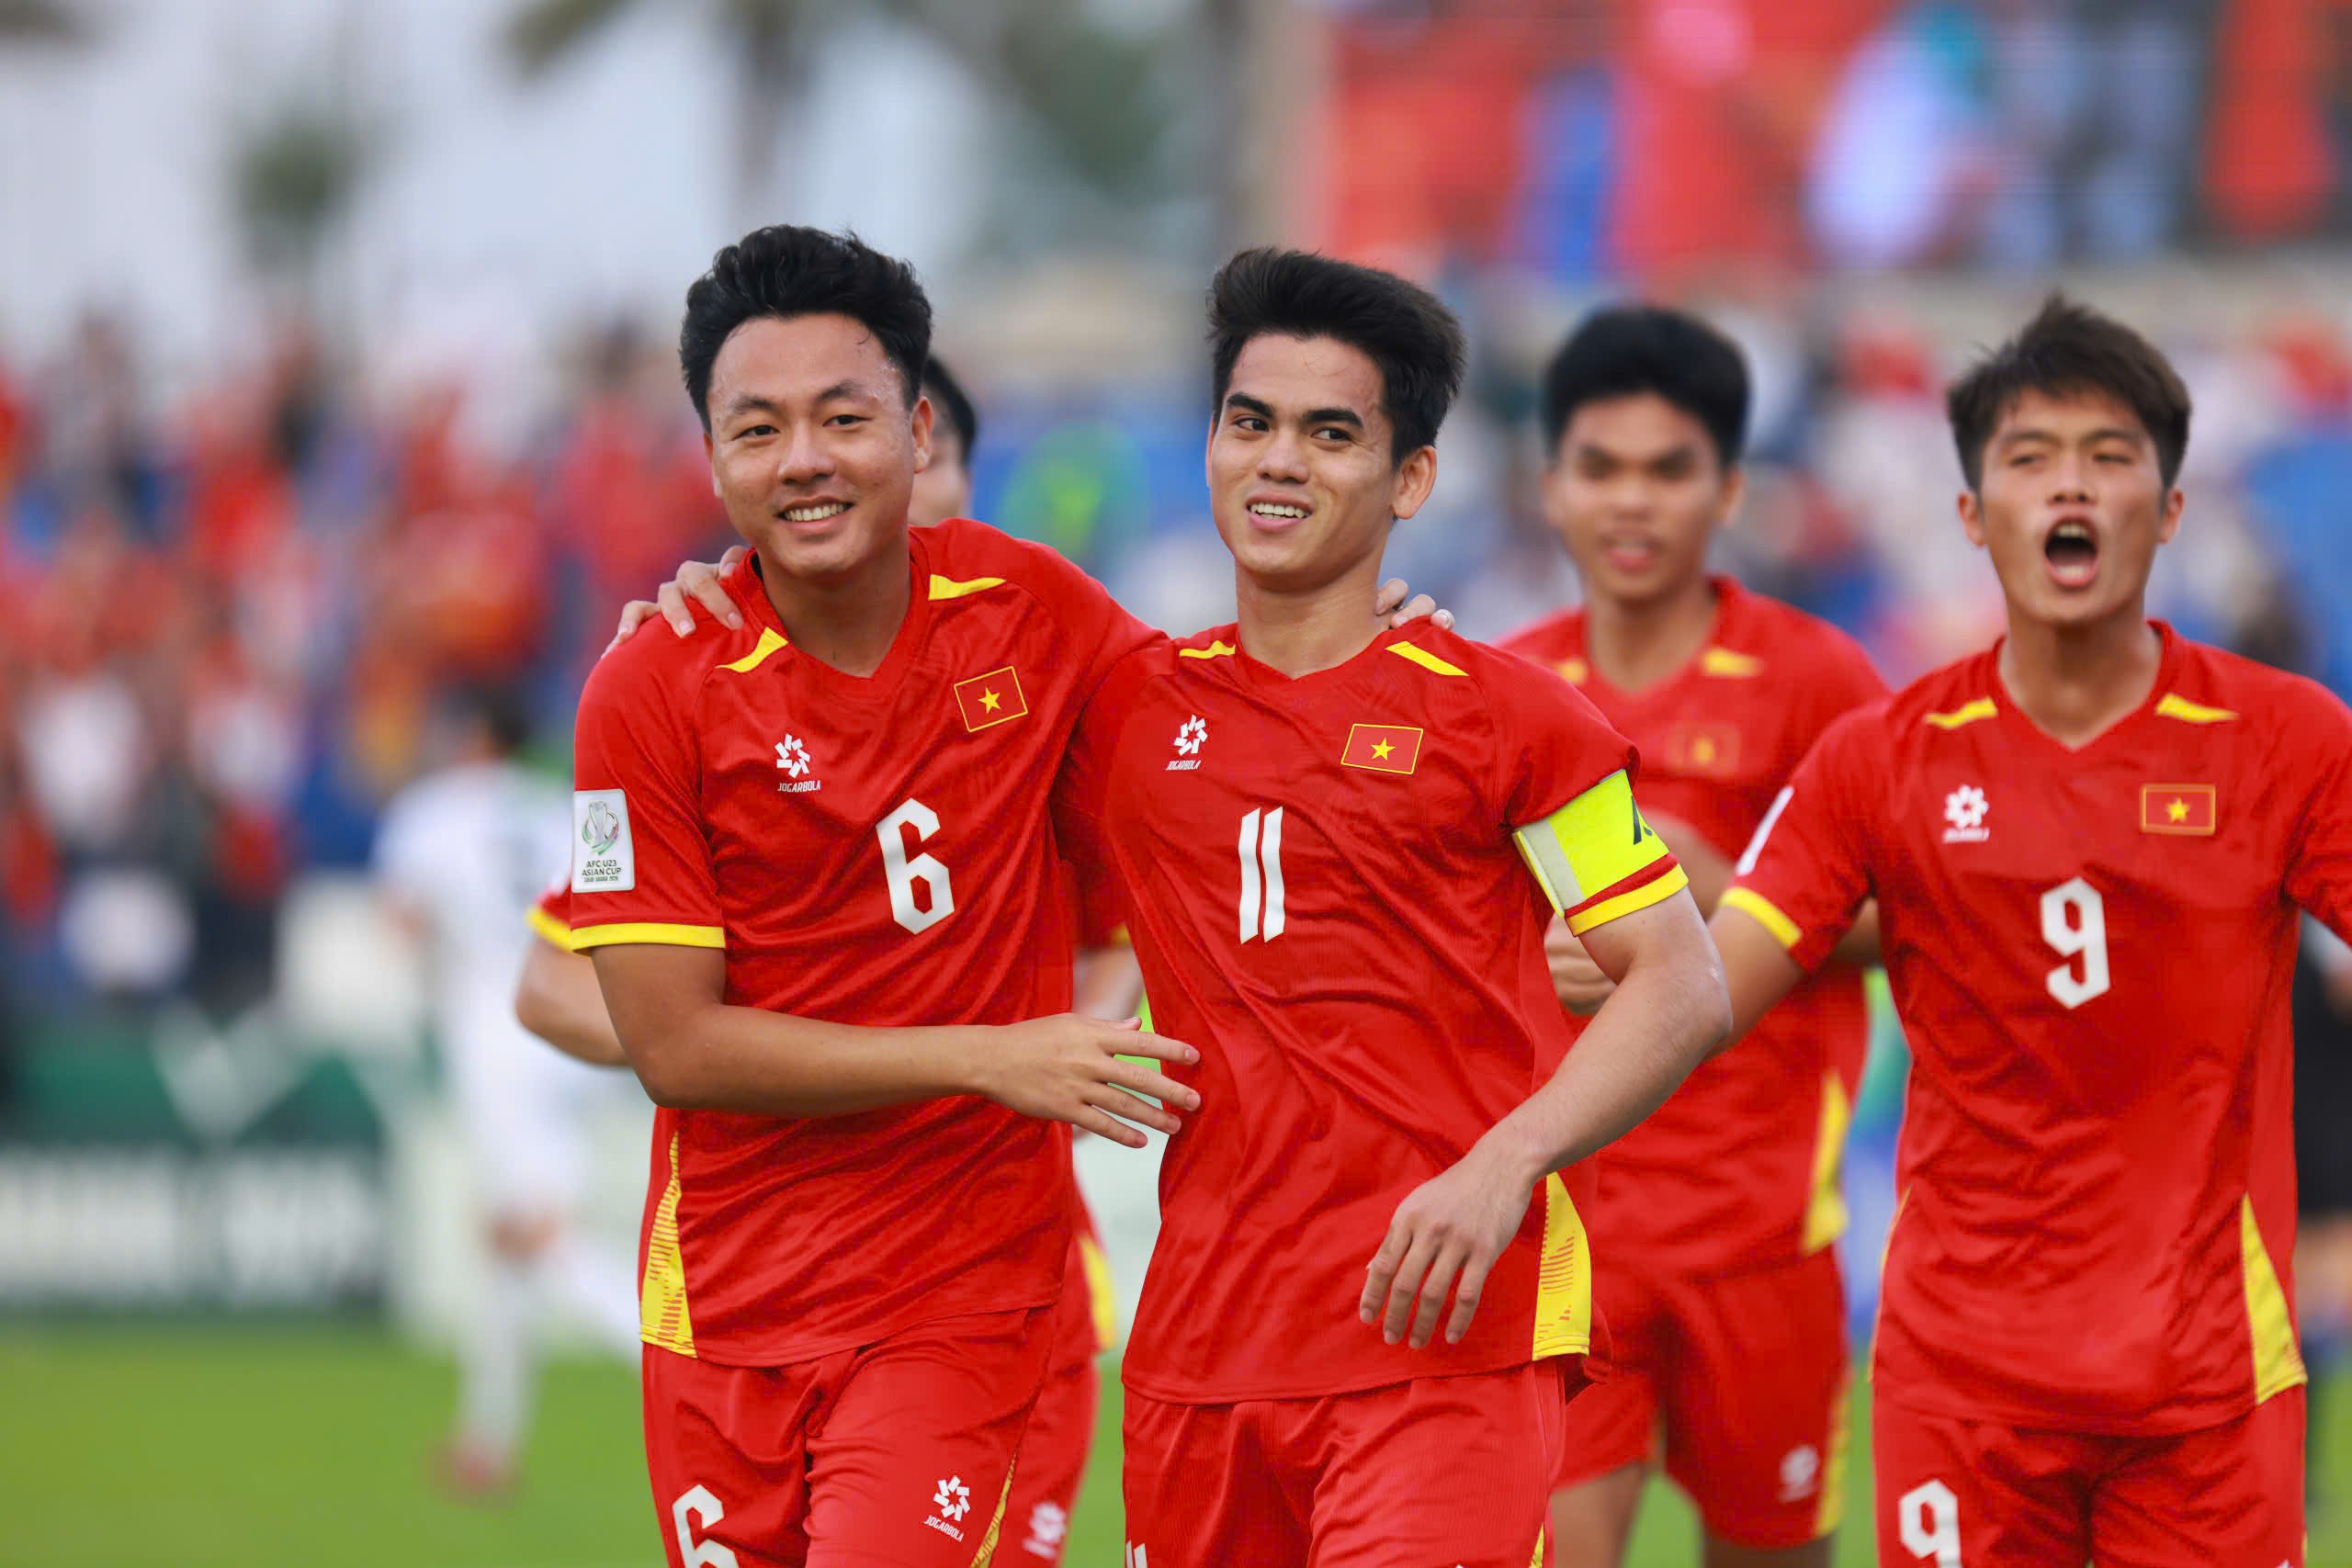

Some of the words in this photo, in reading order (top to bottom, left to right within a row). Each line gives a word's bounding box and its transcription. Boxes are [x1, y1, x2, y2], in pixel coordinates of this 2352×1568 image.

[777, 779, 821, 793] JOGARBOLA
[586, 860, 602, 868] AFC
[603, 859, 617, 867] U23
[605, 867, 621, 875] CUP
[876, 797, 956, 935] 6
[1238, 806, 1285, 945] 11
[2041, 876, 2110, 1010] 9
[922, 1515, 965, 1542] JOGARBOLA
